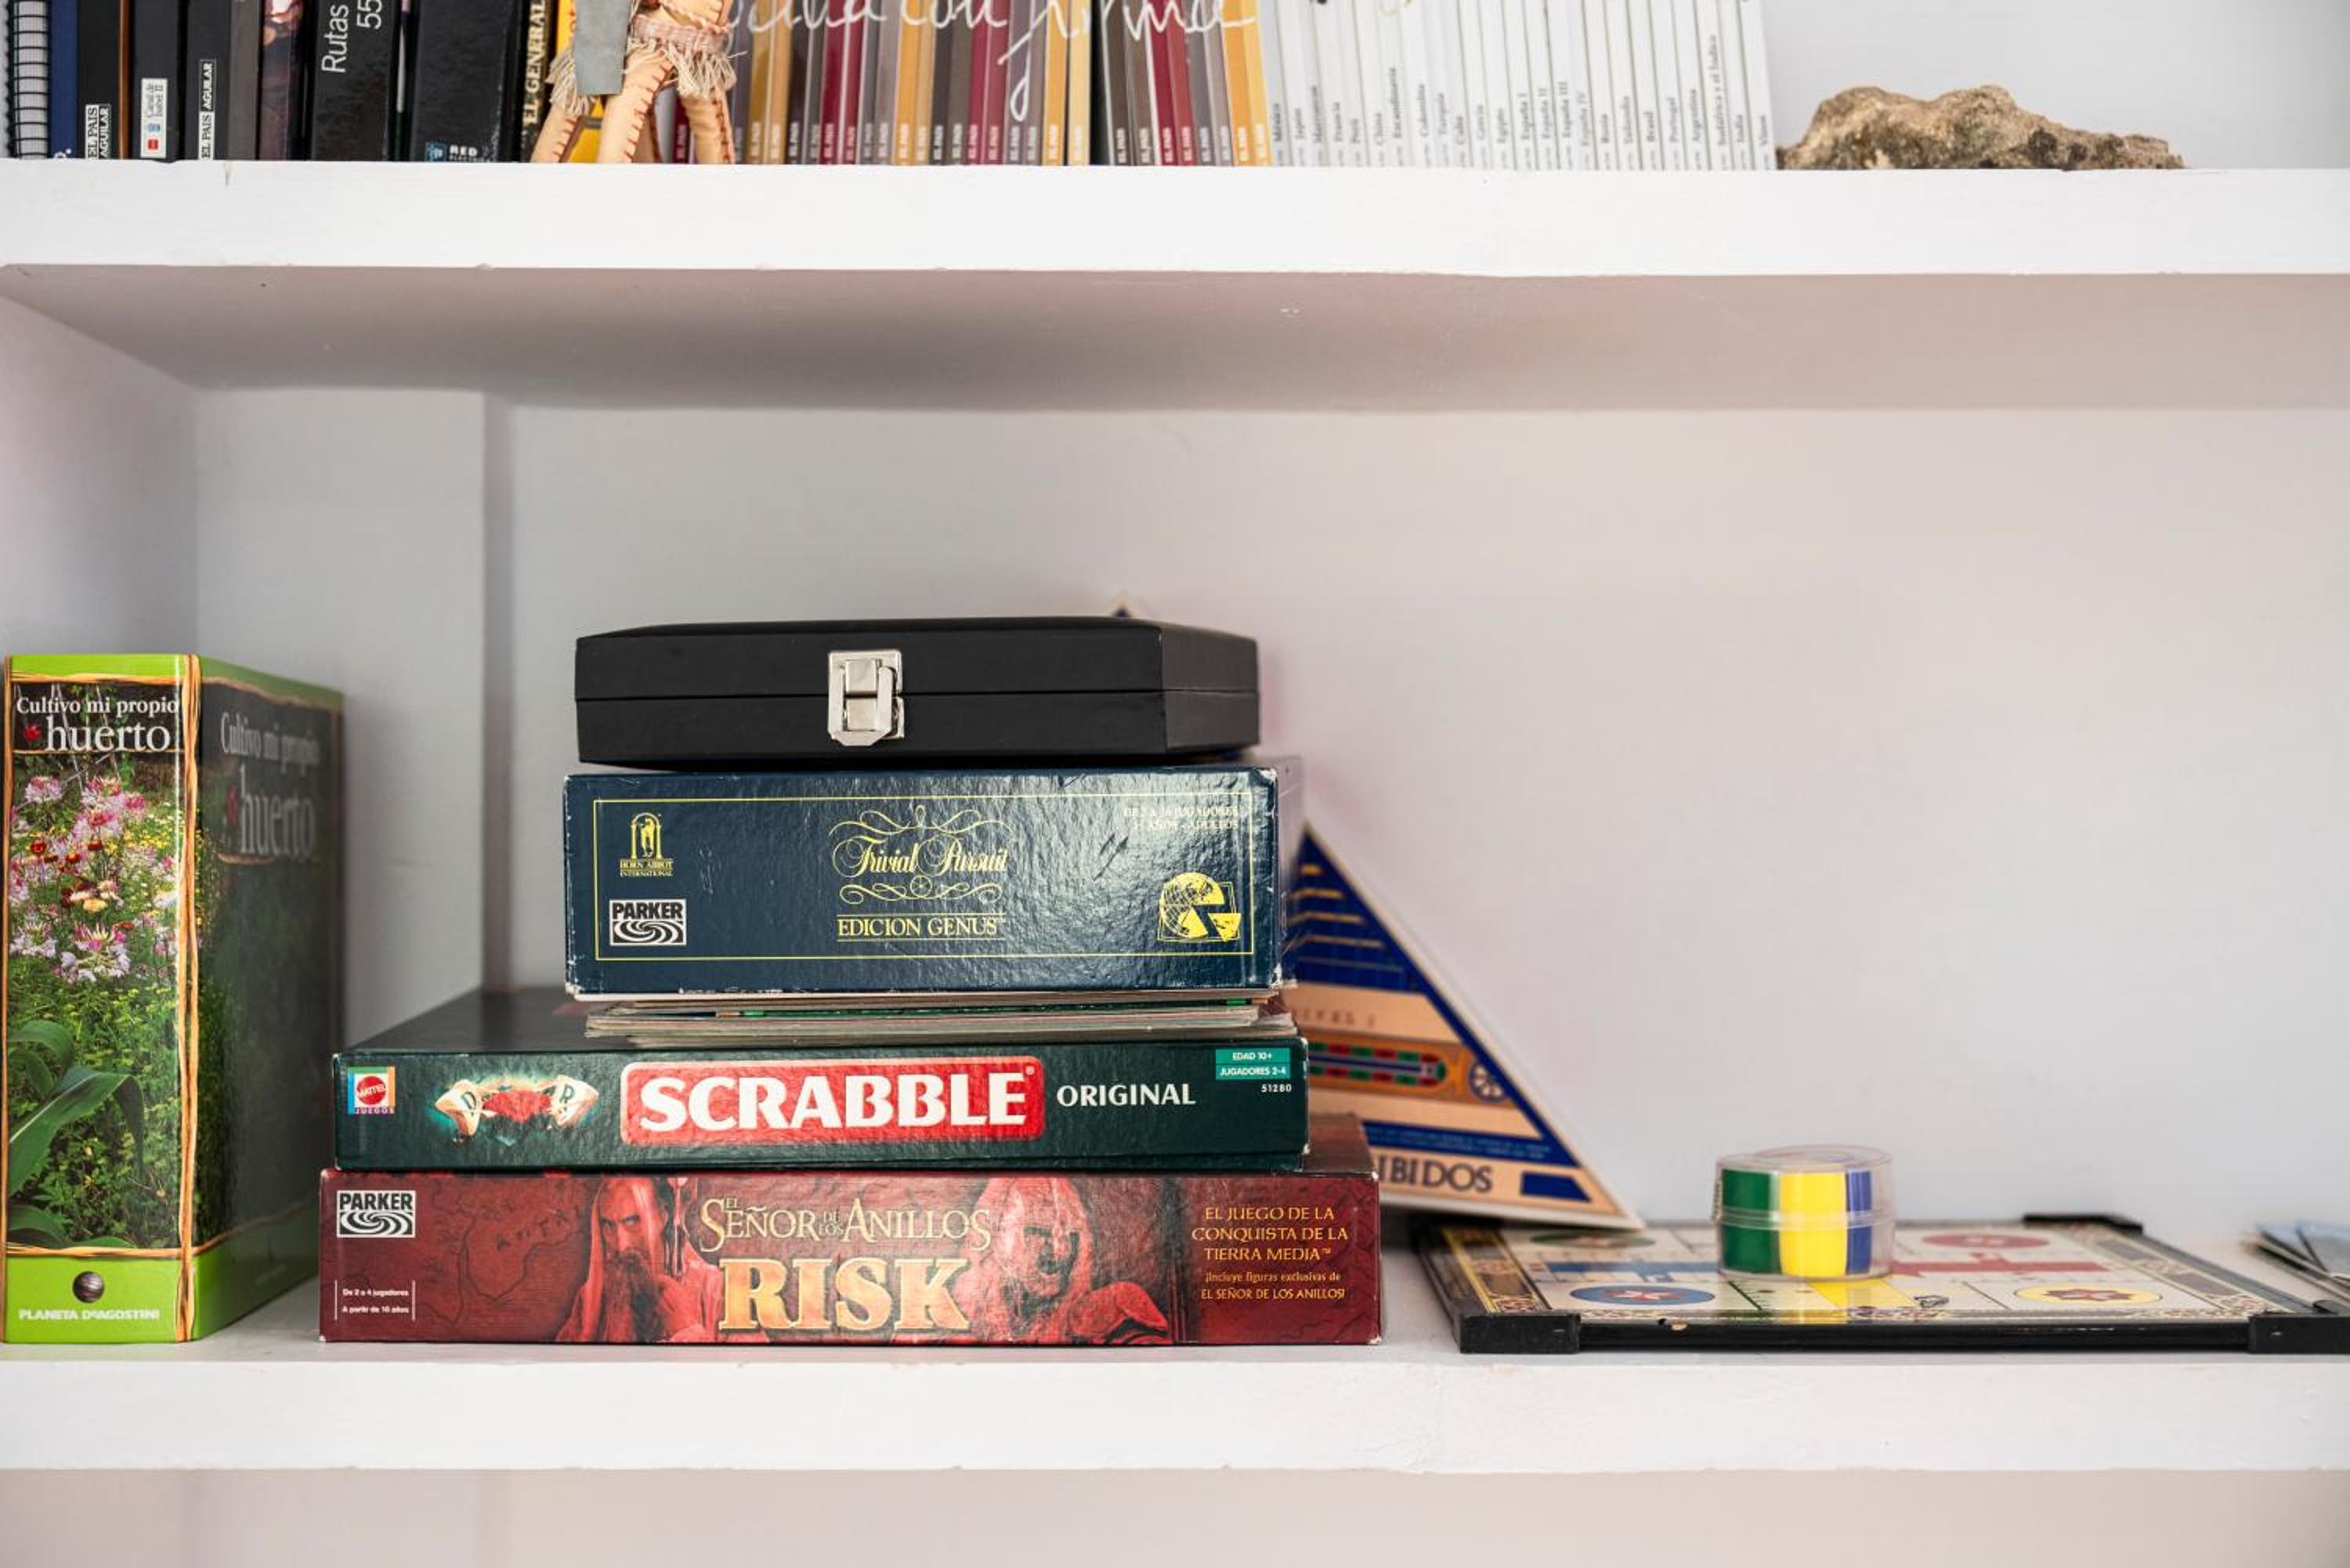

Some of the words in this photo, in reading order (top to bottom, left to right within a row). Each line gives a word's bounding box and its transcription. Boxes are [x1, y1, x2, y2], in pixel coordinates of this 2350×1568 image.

[321, 4, 349, 73] Rutas
[202, 62, 213, 110] AGUILAR
[16, 696, 81, 714] Cultivo
[85, 696, 111, 714] mi
[117, 697, 179, 718] propio
[45, 714, 171, 752] huerto
[239, 761, 316, 860] huerto
[833, 835, 919, 878] Trivial
[916, 833, 1008, 877] Pursuit
[611, 901, 683, 919] PARKER
[837, 917, 920, 937] EDICION
[1231, 1052, 1256, 1061] EDAD
[1258, 1051, 1273, 1060] 10+
[1057, 1082, 1197, 1107] ORIGINAL
[1260, 1083, 1292, 1093] 51280
[339, 1192, 413, 1210] PARKER
[1205, 1207, 1224, 1220] EL
[1227, 1207, 1285, 1221] JUEGO
[1288, 1207, 1311, 1220] DE
[1314, 1207, 1335, 1220] LA
[700, 1198, 822, 1252] SEÑOR
[841, 1197, 992, 1252] ANILLOS
[1191, 1227, 1296, 1242] CONQUISTA
[1301, 1227, 1324, 1241] DE
[1328, 1227, 1348, 1241] LA
[1203, 1247, 1262, 1260] TIERRA
[1246, 1272, 1278, 1284] figuras
[1281, 1272, 1326, 1281] exclusivas
[1329, 1272, 1342, 1281] de
[718, 1257, 971, 1331] RISK
[1201, 1288, 1213, 1300] EL
[1216, 1287, 1253, 1300] SEÑOR
[1256, 1289, 1270, 1300] DE
[1273, 1289, 1293, 1300] LOS
